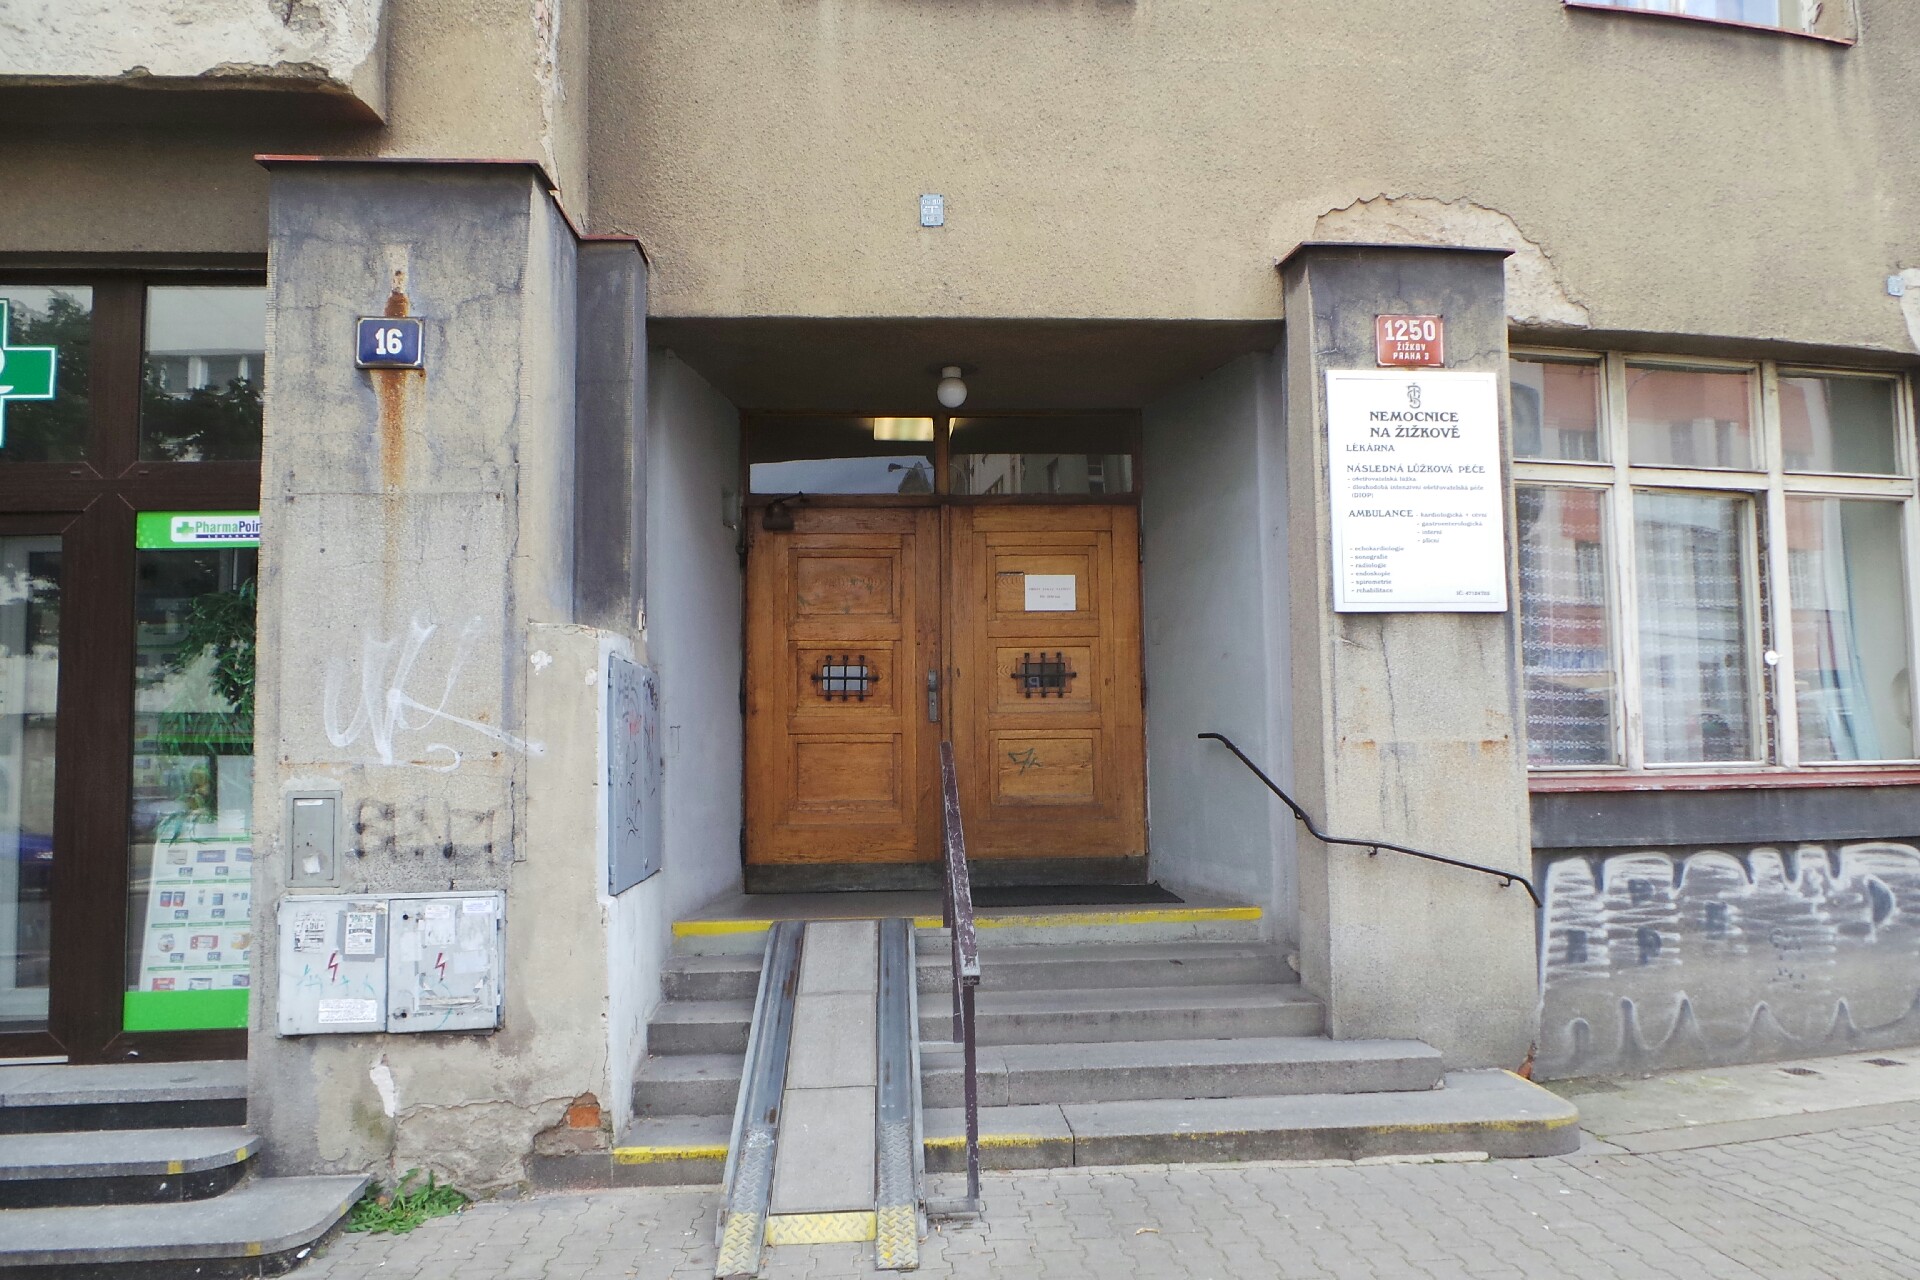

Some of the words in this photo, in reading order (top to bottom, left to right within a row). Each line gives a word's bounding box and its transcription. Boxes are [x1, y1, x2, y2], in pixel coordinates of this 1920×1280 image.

[1384, 319, 1436, 341] 1250
[375, 327, 403, 355] 16
[1397, 341, 1426, 351] ŽIŽKOV
[1392, 352, 1421, 360] PRAHA
[1369, 411, 1459, 422] NEMOCNICE
[1370, 427, 1391, 438] NA
[1395, 424, 1461, 439] ŽIŽKOVĚ
[1346, 442, 1395, 452] LÉKÁRNA
[1347, 462, 1404, 473] NÁSLEDNÁ
[1458, 464, 1486, 474] PÉČE
[1349, 509, 1414, 518] AMBULANCE
